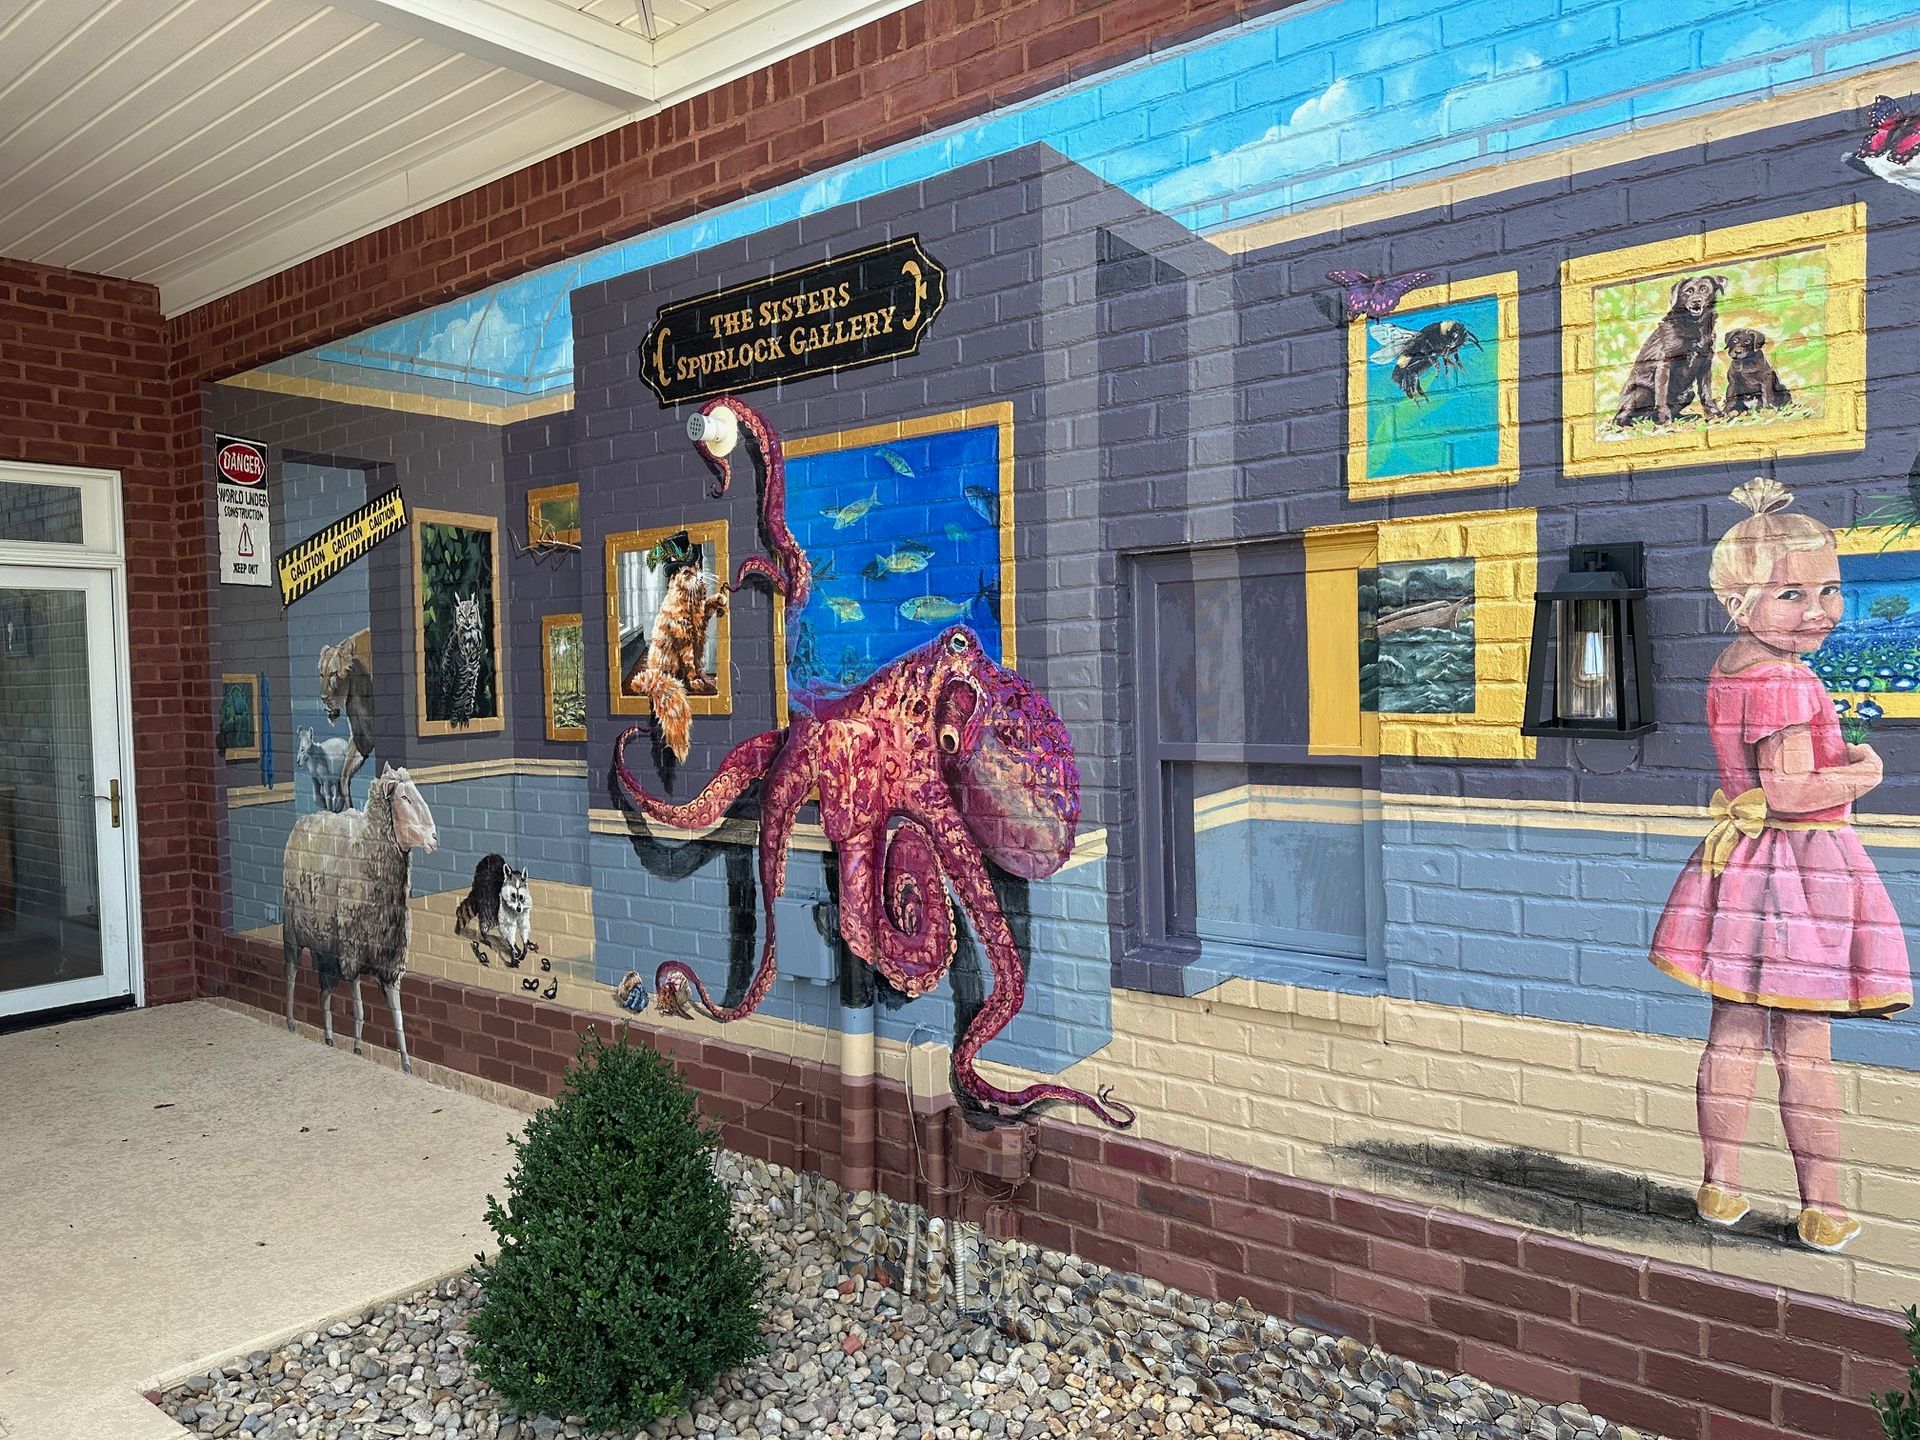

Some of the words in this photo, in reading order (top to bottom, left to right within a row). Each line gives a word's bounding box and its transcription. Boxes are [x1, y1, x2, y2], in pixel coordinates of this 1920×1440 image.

[710, 309, 753, 339] THE
[759, 282, 851, 327] SISTERS
[677, 336, 785, 381] SPURLOCK
[789, 306, 896, 356] GALLERY
[223, 451, 262, 475] DANGER
[218, 487, 244, 505] WORLD
[246, 490, 268, 508] UNDER
[224, 507, 264, 520] CONSTRUCTION
[290, 549, 325, 582] CAUTION
[332, 526, 363, 554] CAUTION
[368, 505, 396, 531] CAUTION
[232, 562, 247, 574] KEEP
[248, 563, 259, 575] OUT
